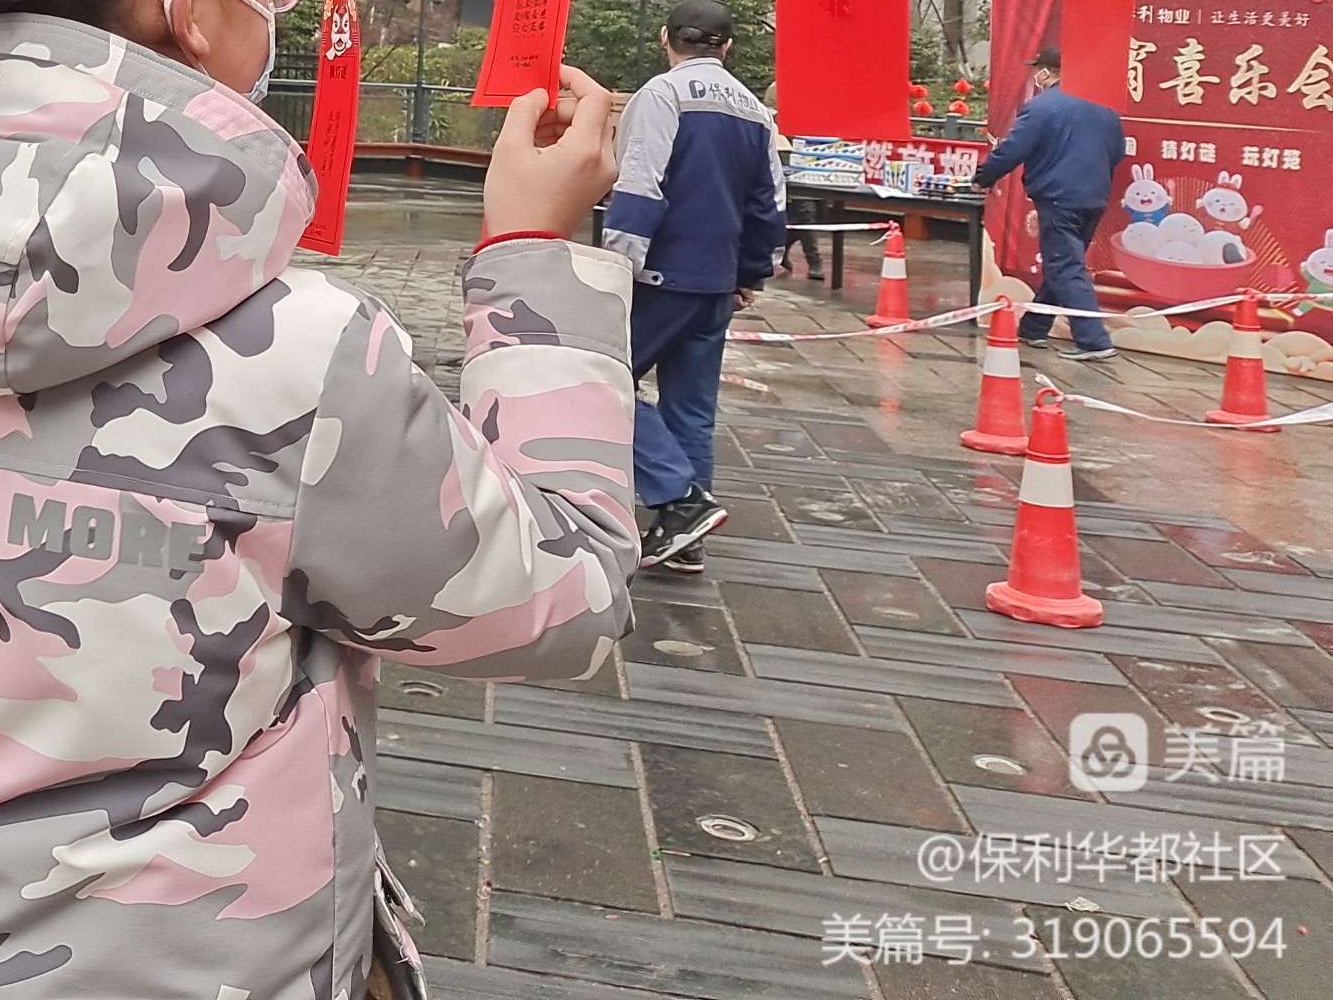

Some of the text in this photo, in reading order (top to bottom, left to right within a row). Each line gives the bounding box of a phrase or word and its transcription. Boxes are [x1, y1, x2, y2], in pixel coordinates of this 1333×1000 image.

[1132, 5, 1311, 28] 利物业 让生活更美好
[1161, 140, 1217, 163] 猜灯谜
[1242, 146, 1302, 170] 玩灯笼
[6, 494, 208, 573] MORE
